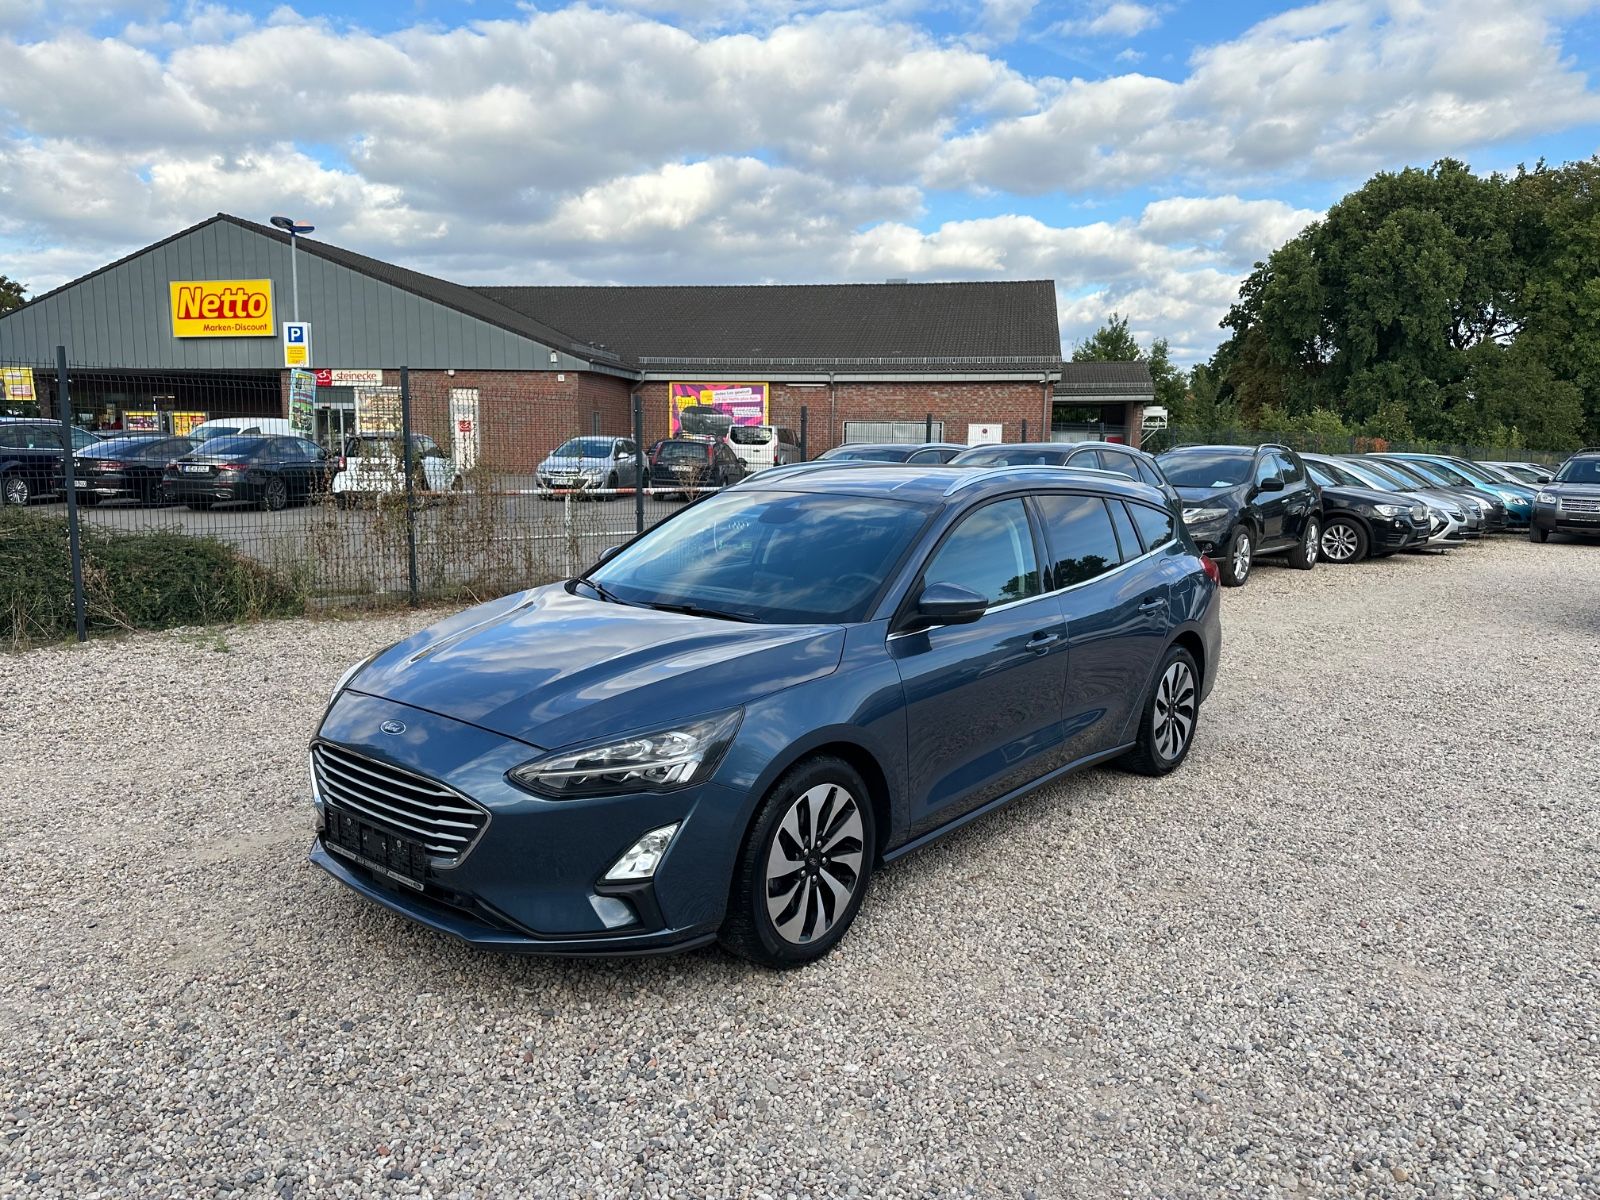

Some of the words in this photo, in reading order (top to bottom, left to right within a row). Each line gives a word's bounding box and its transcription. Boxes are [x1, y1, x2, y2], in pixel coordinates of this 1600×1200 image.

[177, 286, 268, 320] Netto
[203, 323, 267, 332] Marken-Discount
[290, 327, 301, 342] P
[336, 371, 377, 381] steinecke
